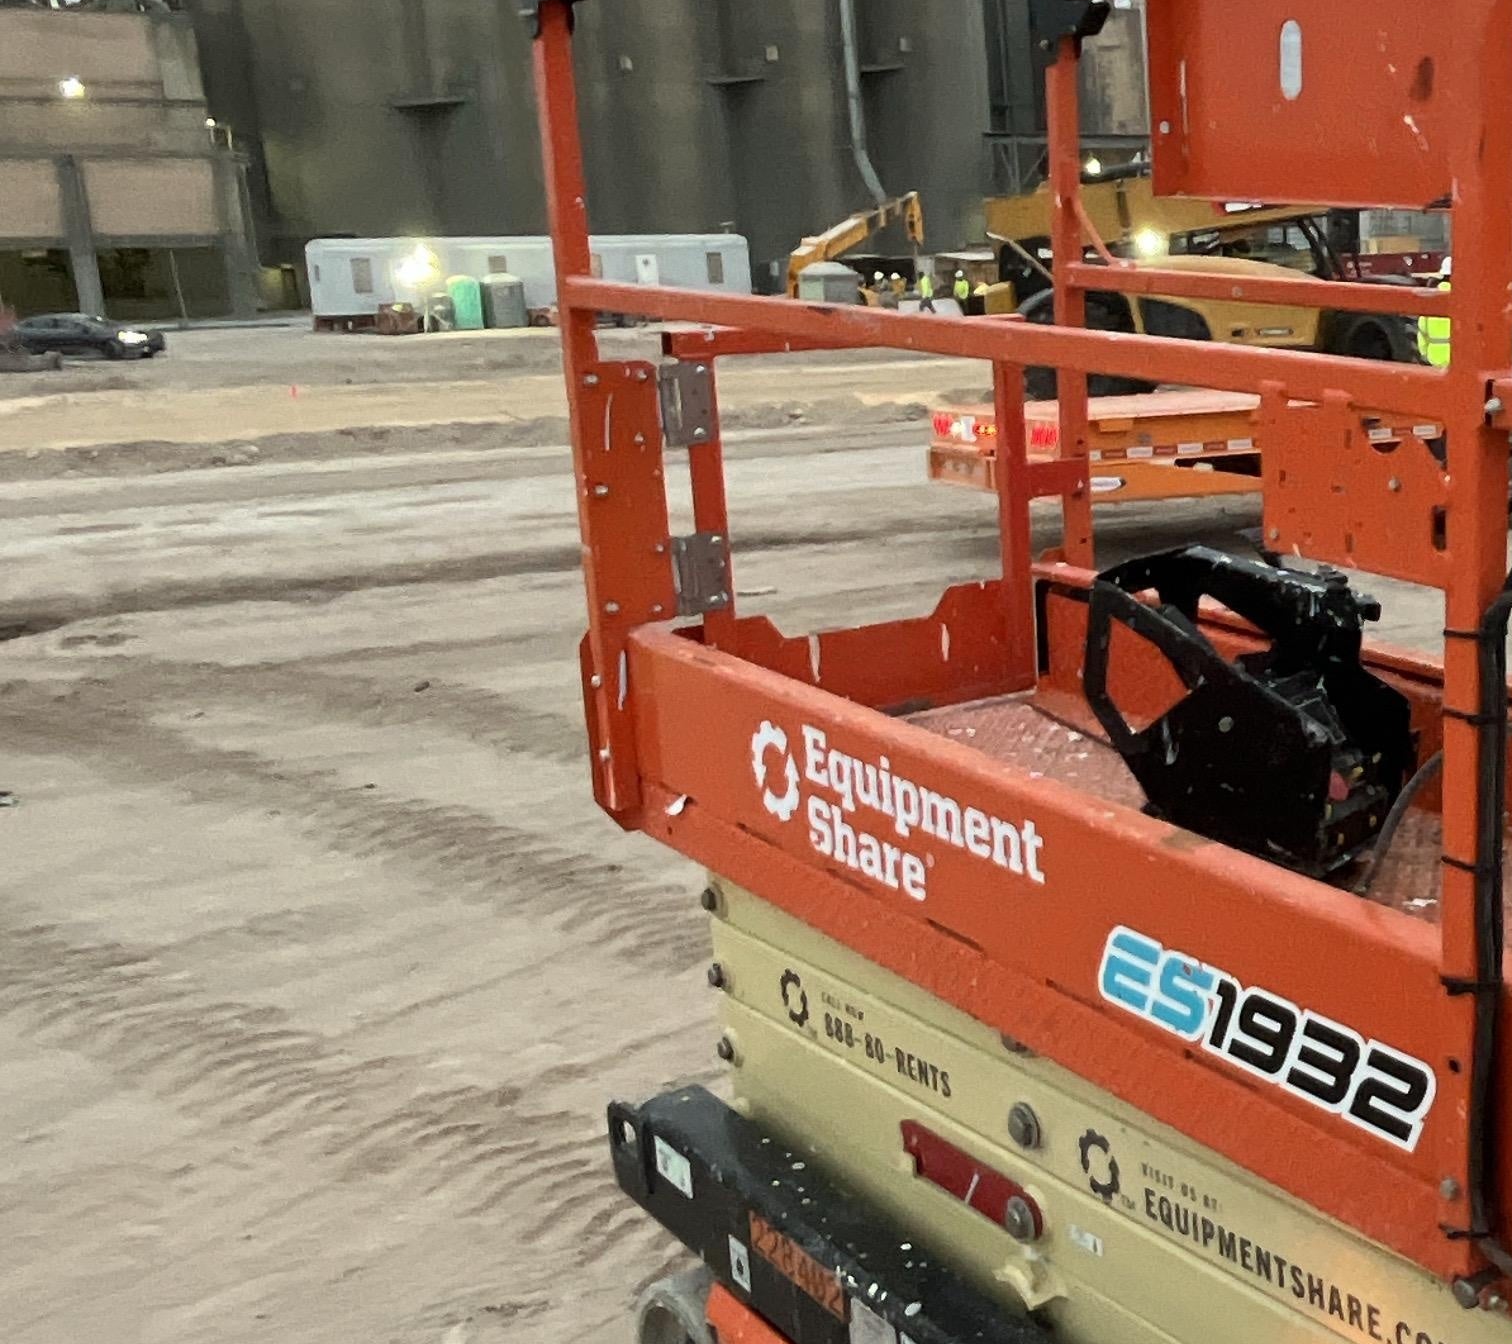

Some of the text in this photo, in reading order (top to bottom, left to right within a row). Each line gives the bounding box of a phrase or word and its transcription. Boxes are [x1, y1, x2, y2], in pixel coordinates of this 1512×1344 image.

[801, 724, 1045, 885] Equipment
[807, 795, 926, 902] Share
[1100, 927, 1434, 1148] ES1932
